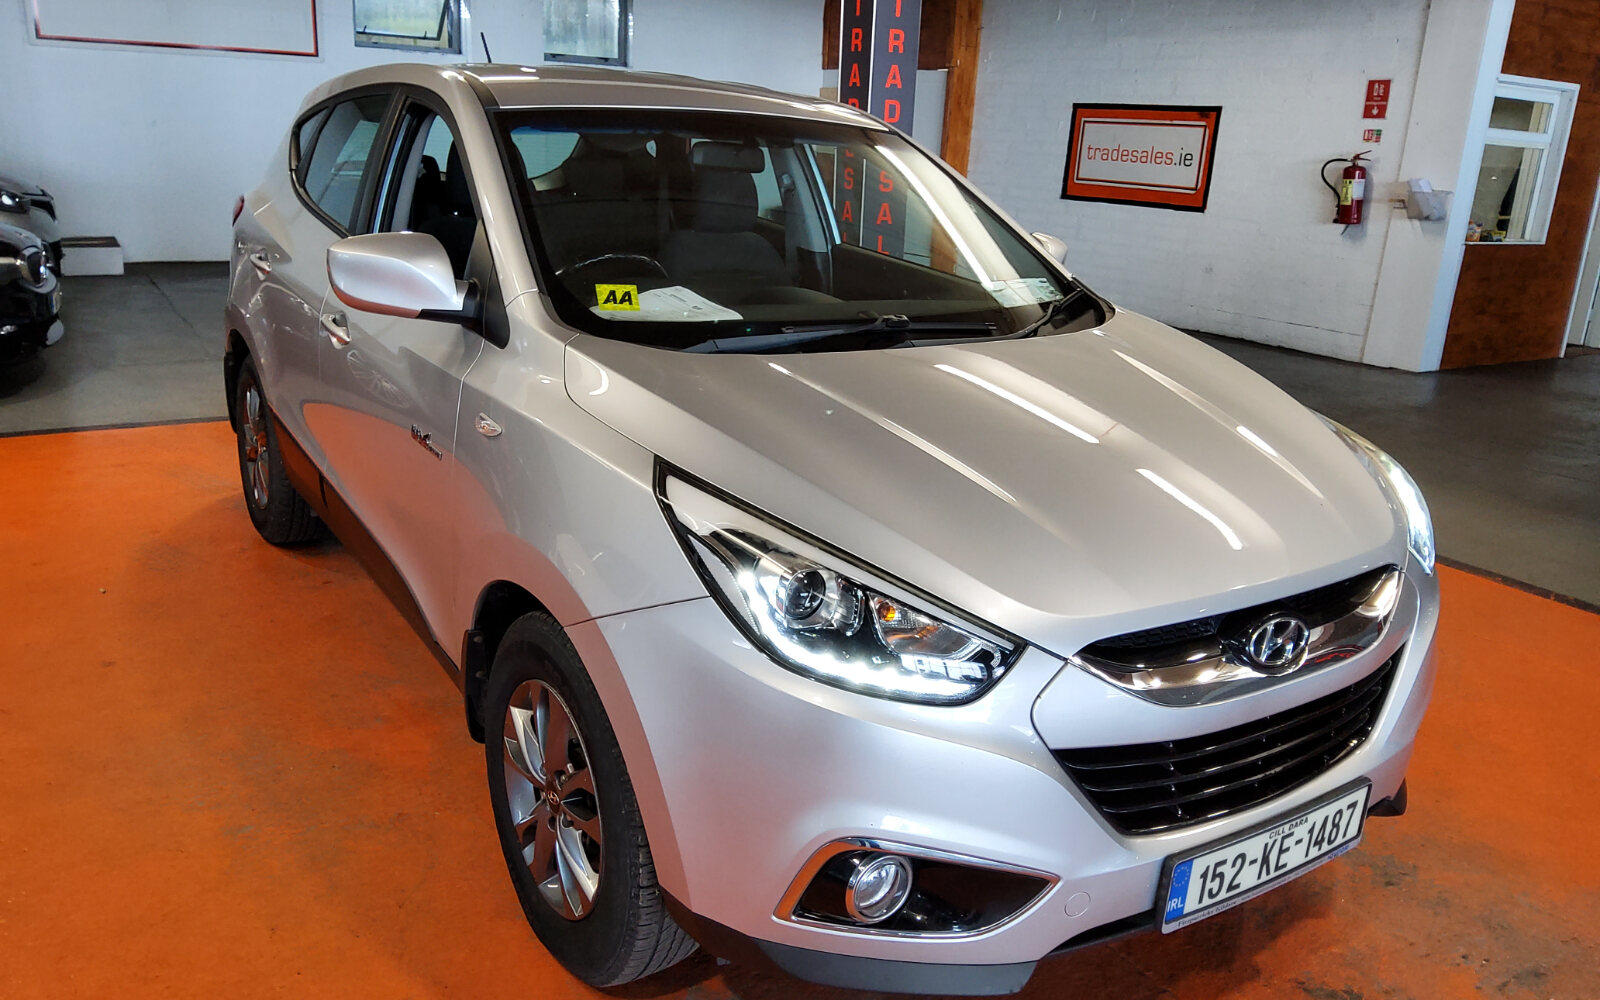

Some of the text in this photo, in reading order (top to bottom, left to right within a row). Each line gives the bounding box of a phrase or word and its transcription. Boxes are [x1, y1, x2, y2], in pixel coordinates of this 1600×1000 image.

[1087, 144, 1194, 167] tradesales.ie
[602, 290, 633, 305] AA
[1269, 817, 1309, 840] CILL DARA
[1198, 800, 1359, 904] 152-KE-1487
[1167, 897, 1183, 912] IRL
